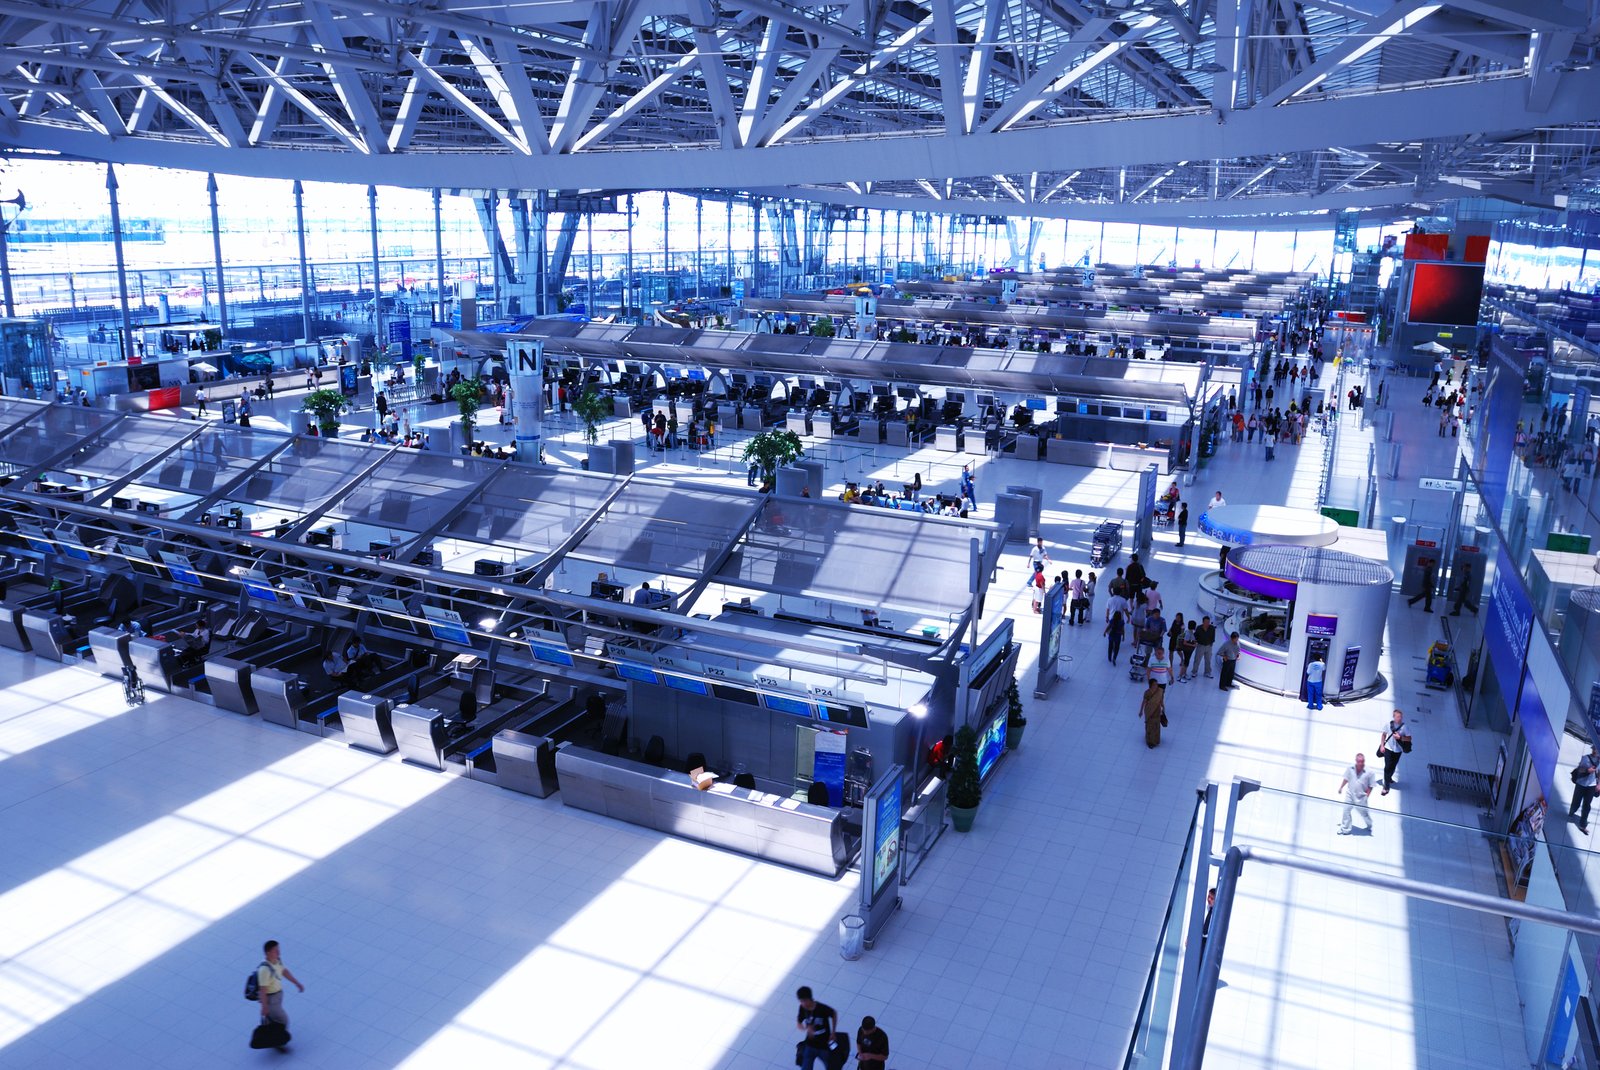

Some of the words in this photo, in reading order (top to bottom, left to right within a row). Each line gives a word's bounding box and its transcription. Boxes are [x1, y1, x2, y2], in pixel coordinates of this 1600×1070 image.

[736, 266, 742, 275] K
[1010, 282, 1017, 293] J
[865, 301, 874, 315] L
[518, 348, 537, 371] N
[370, 597, 383, 605] P17
[444, 611, 459, 621] P18
[525, 629, 541, 637] P19
[610, 647, 626, 656] P20
[658, 656, 674, 666] P21
[708, 667, 725, 677] P22
[760, 677, 778, 687] P23
[814, 687, 833, 697] P24
